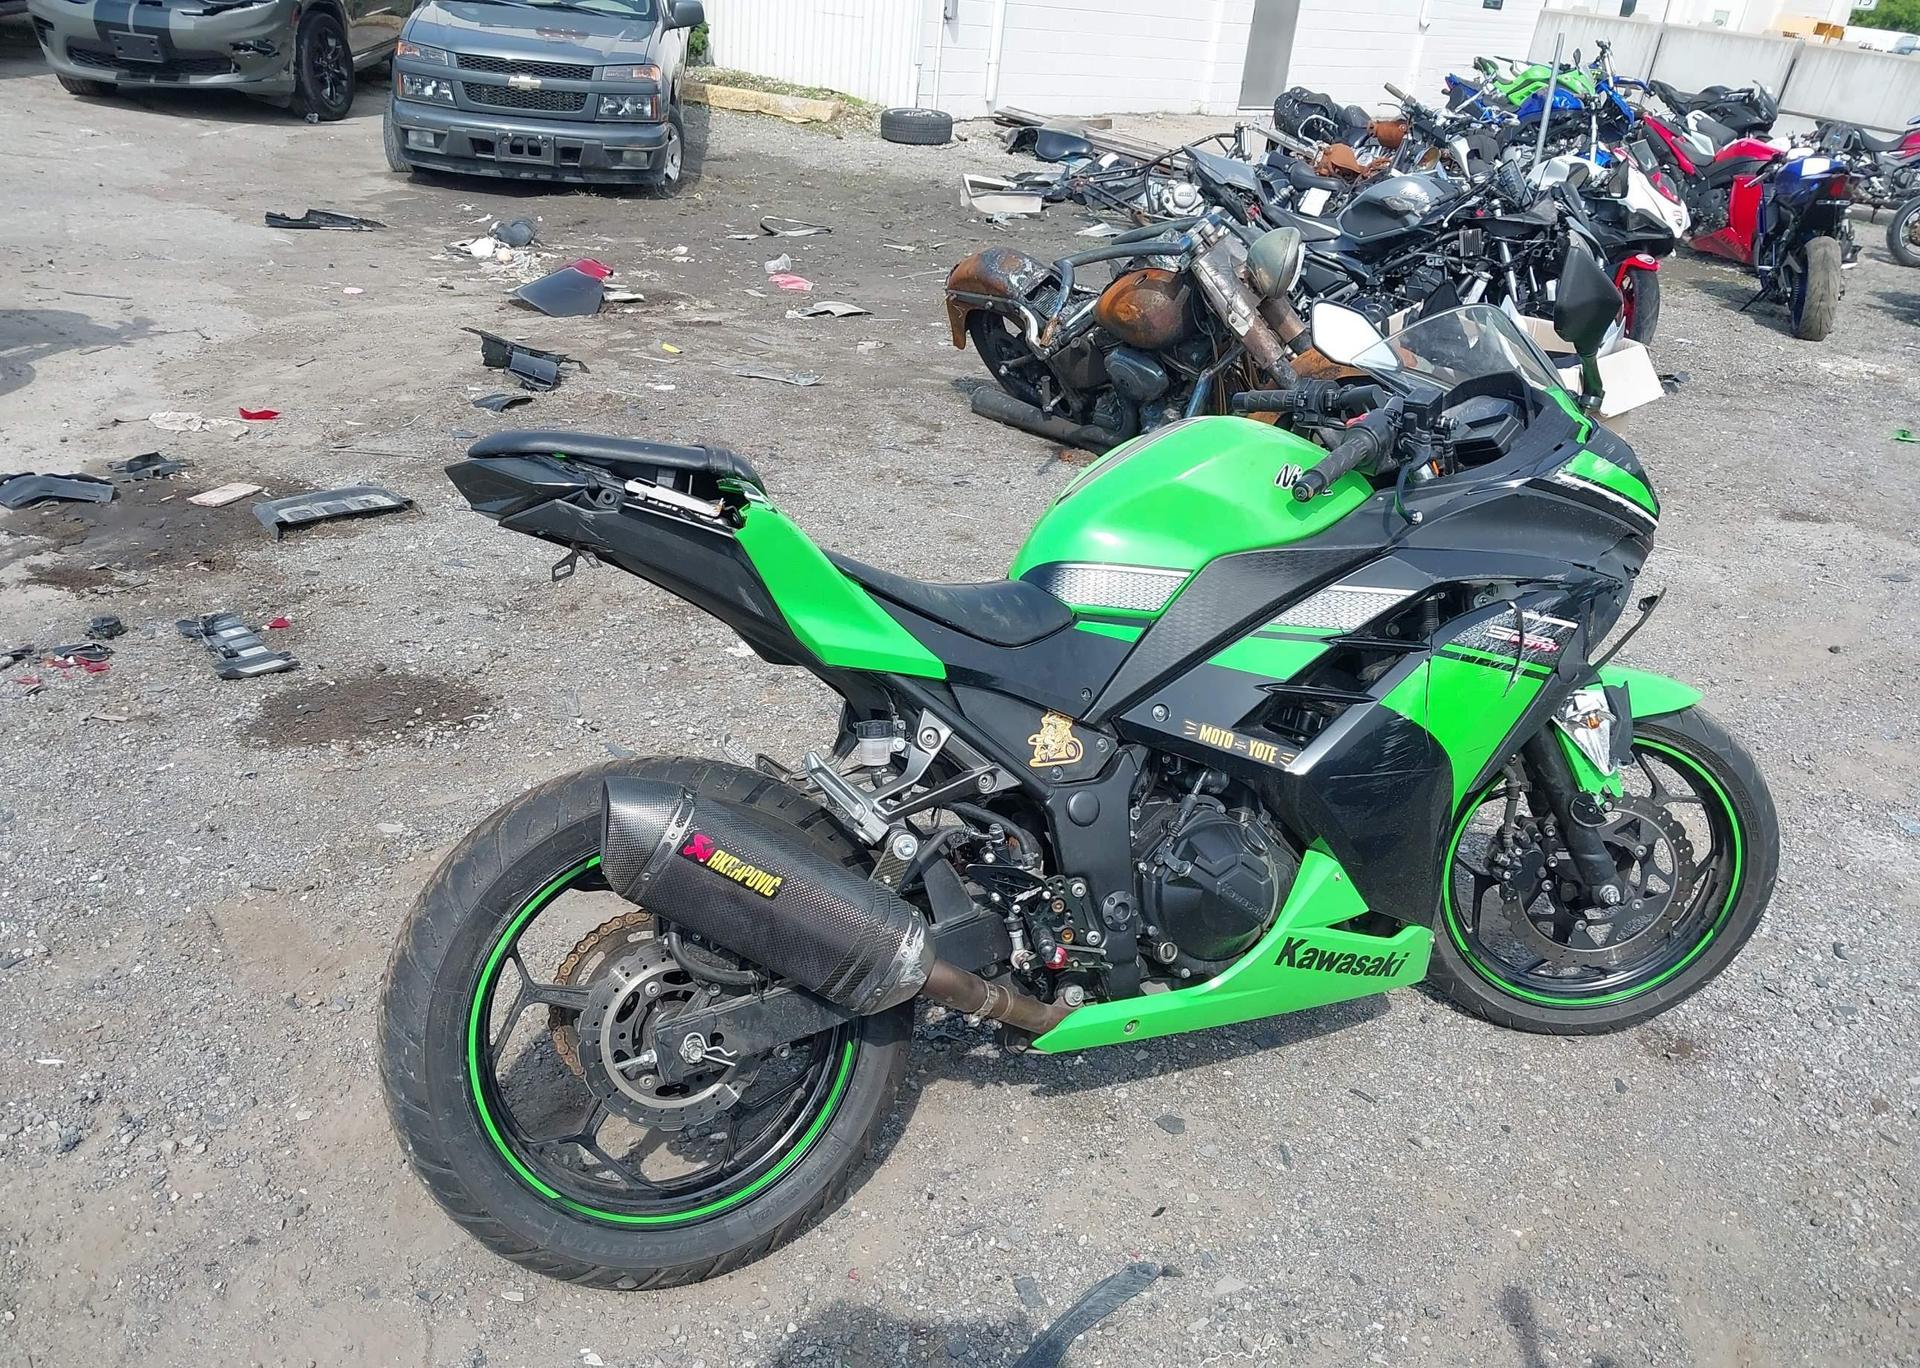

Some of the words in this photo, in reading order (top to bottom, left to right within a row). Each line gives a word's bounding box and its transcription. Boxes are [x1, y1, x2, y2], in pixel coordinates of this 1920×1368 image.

[1198, 724, 1234, 749] MOTO
[1248, 740, 1278, 764] YOTE
[1274, 936, 1411, 977] Kawasaki
